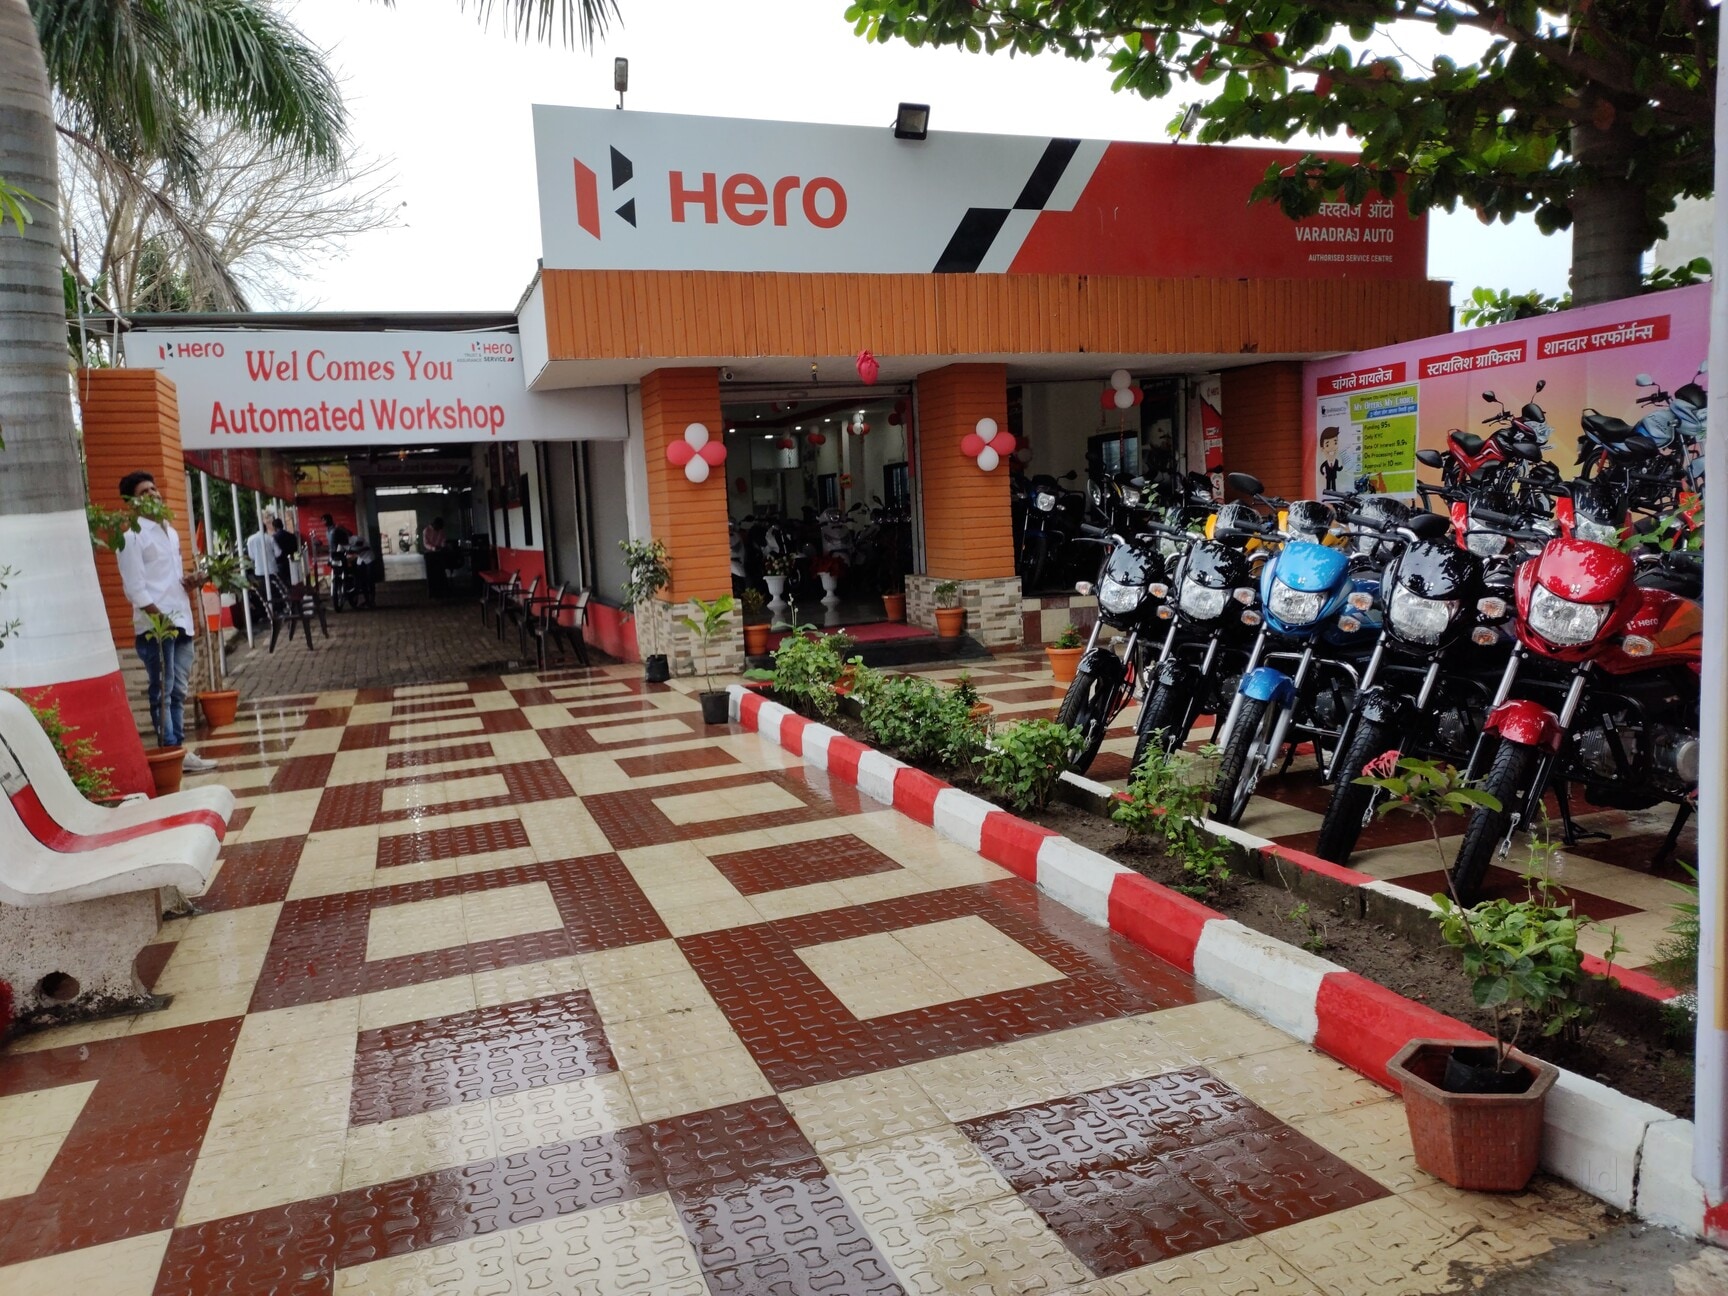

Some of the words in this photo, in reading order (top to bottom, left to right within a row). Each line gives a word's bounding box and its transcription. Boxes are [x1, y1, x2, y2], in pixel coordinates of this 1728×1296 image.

[669, 170, 848, 229] Hero
[1368, 199, 1395, 219] ऑटो
[1295, 226, 1360, 242] VARADRAJ
[1363, 228, 1394, 243] AUTO
[1308, 254, 1345, 262] AUTHORISED
[1346, 254, 1370, 262] SERVICE
[1371, 255, 1393, 263] CENTRE
[177, 341, 225, 358] Hero
[482, 343, 513, 355] Hero
[1543, 335, 1588, 356] शानदार
[1591, 322, 1654, 351] परफॉर्मन्स
[245, 350, 298, 381] Wel
[306, 350, 395, 382] Comes
[402, 350, 453, 381] You
[1427, 352, 1473, 376] स्टायलिश
[1475, 346, 1522, 369] ग्राफिक्स
[1331, 375, 1357, 391] चांगले
[1358, 368, 1393, 388] मायलेज
[210, 400, 364, 435] Automated
[370, 399, 505, 436] Workshop
[1637, 617, 1659, 627] Hero
